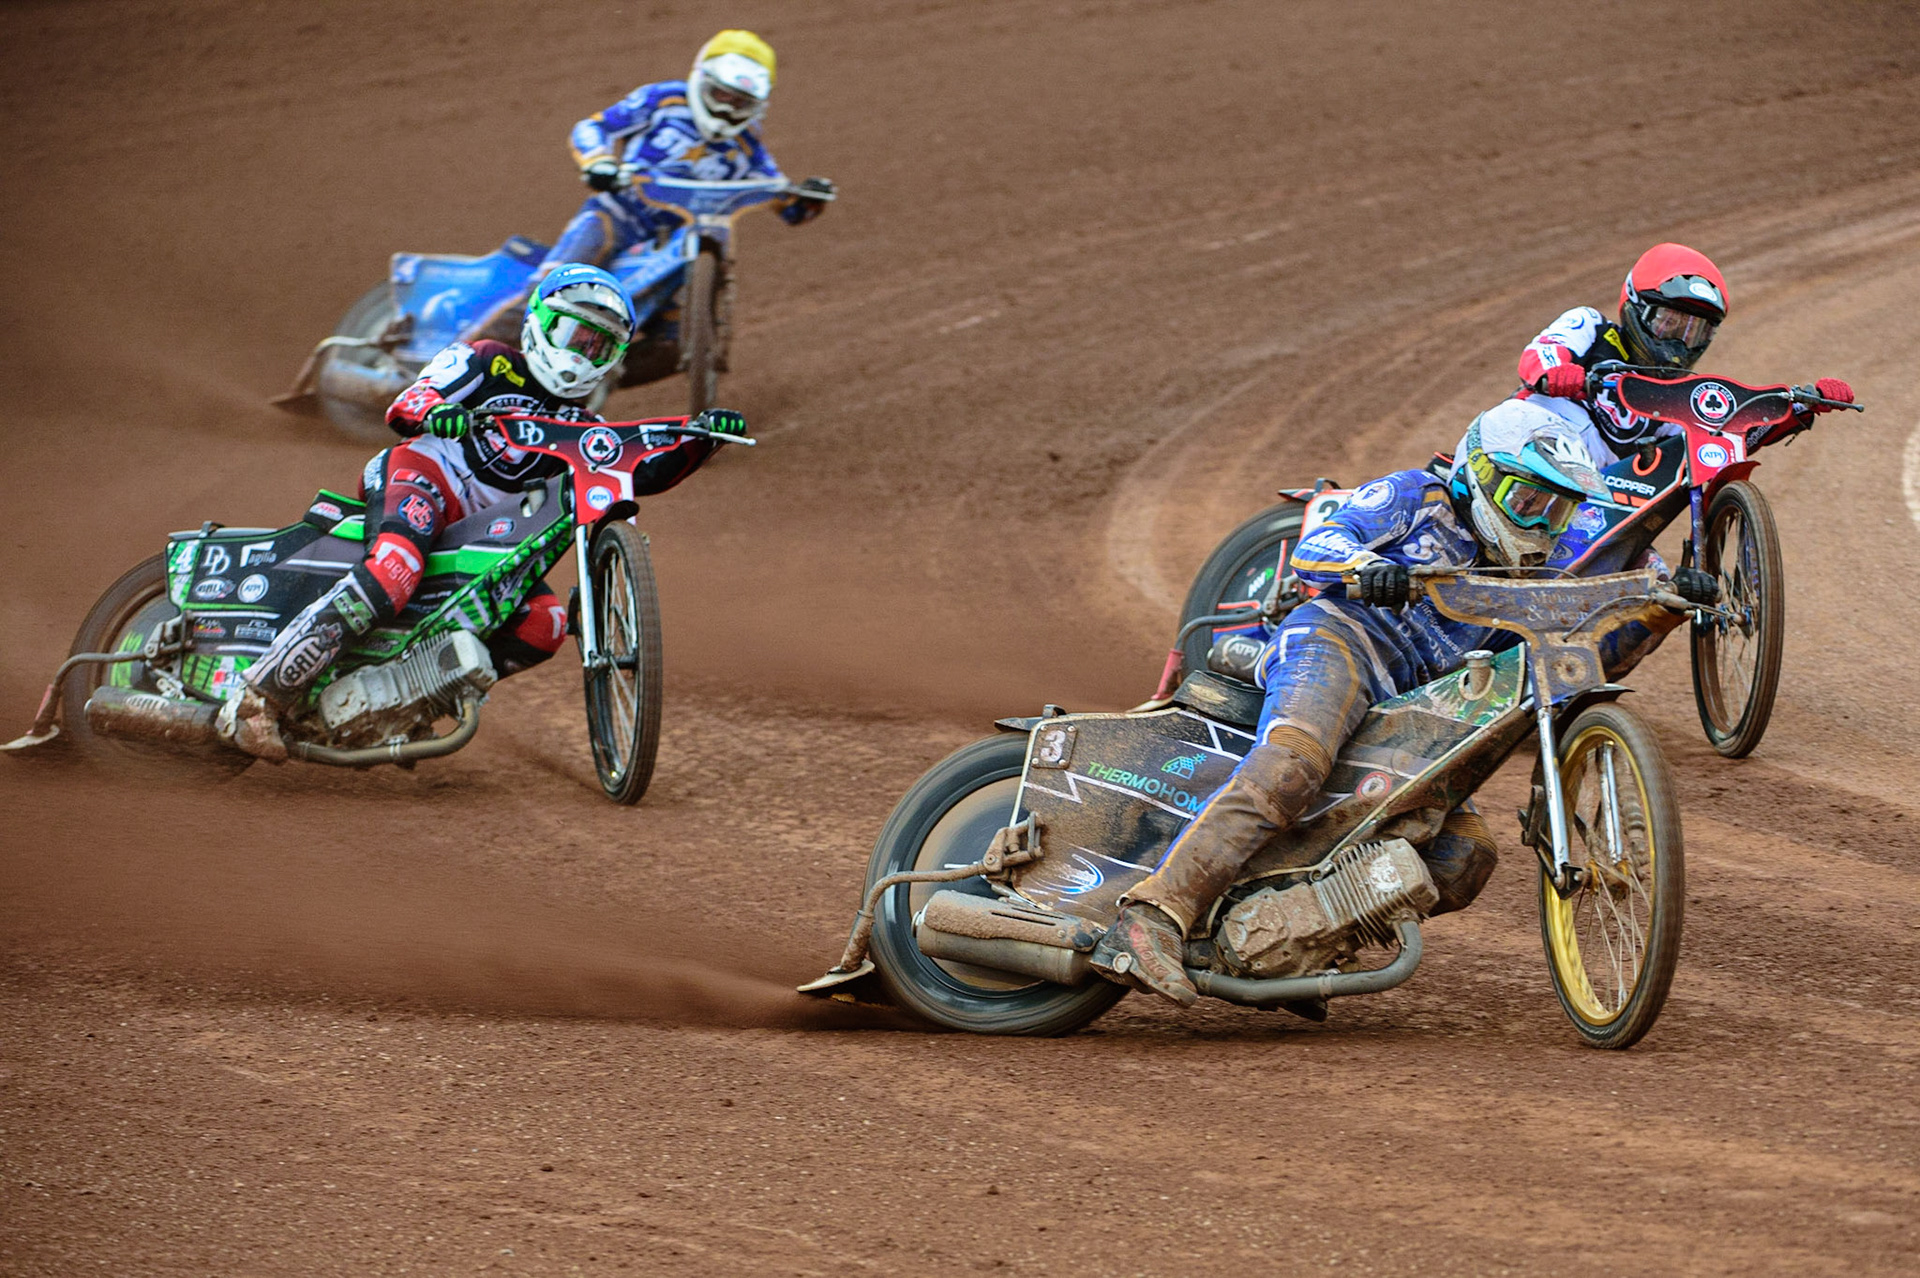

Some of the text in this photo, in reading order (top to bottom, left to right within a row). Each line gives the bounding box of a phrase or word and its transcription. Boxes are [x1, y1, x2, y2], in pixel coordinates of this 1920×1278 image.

[1602, 475, 1656, 496] COPPER
[1230, 642, 1258, 658] ATPI
[1040, 729, 1067, 763] 3
